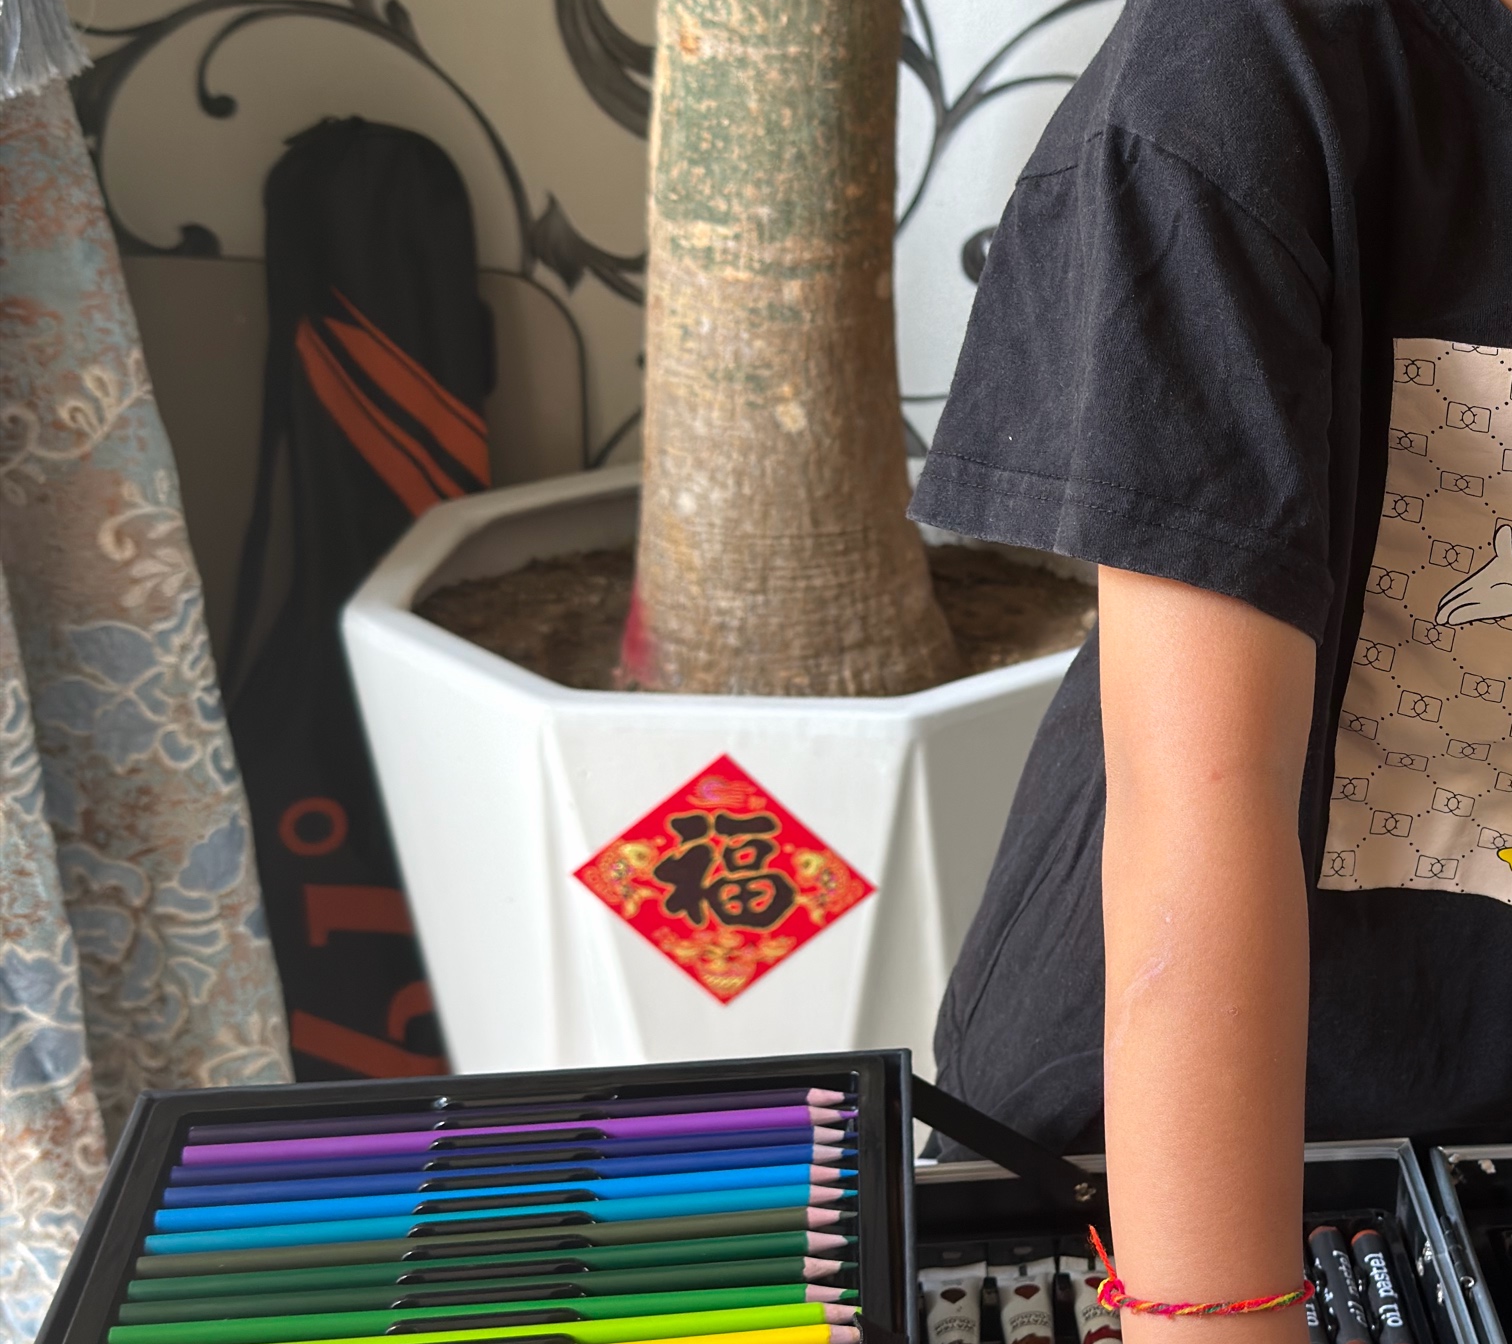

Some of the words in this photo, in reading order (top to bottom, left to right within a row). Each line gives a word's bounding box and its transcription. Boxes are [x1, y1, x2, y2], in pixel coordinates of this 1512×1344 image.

[653, 813, 797, 928] 福
[1364, 1252, 1398, 1299] pastel
[1379, 1303, 1403, 1327] oil
